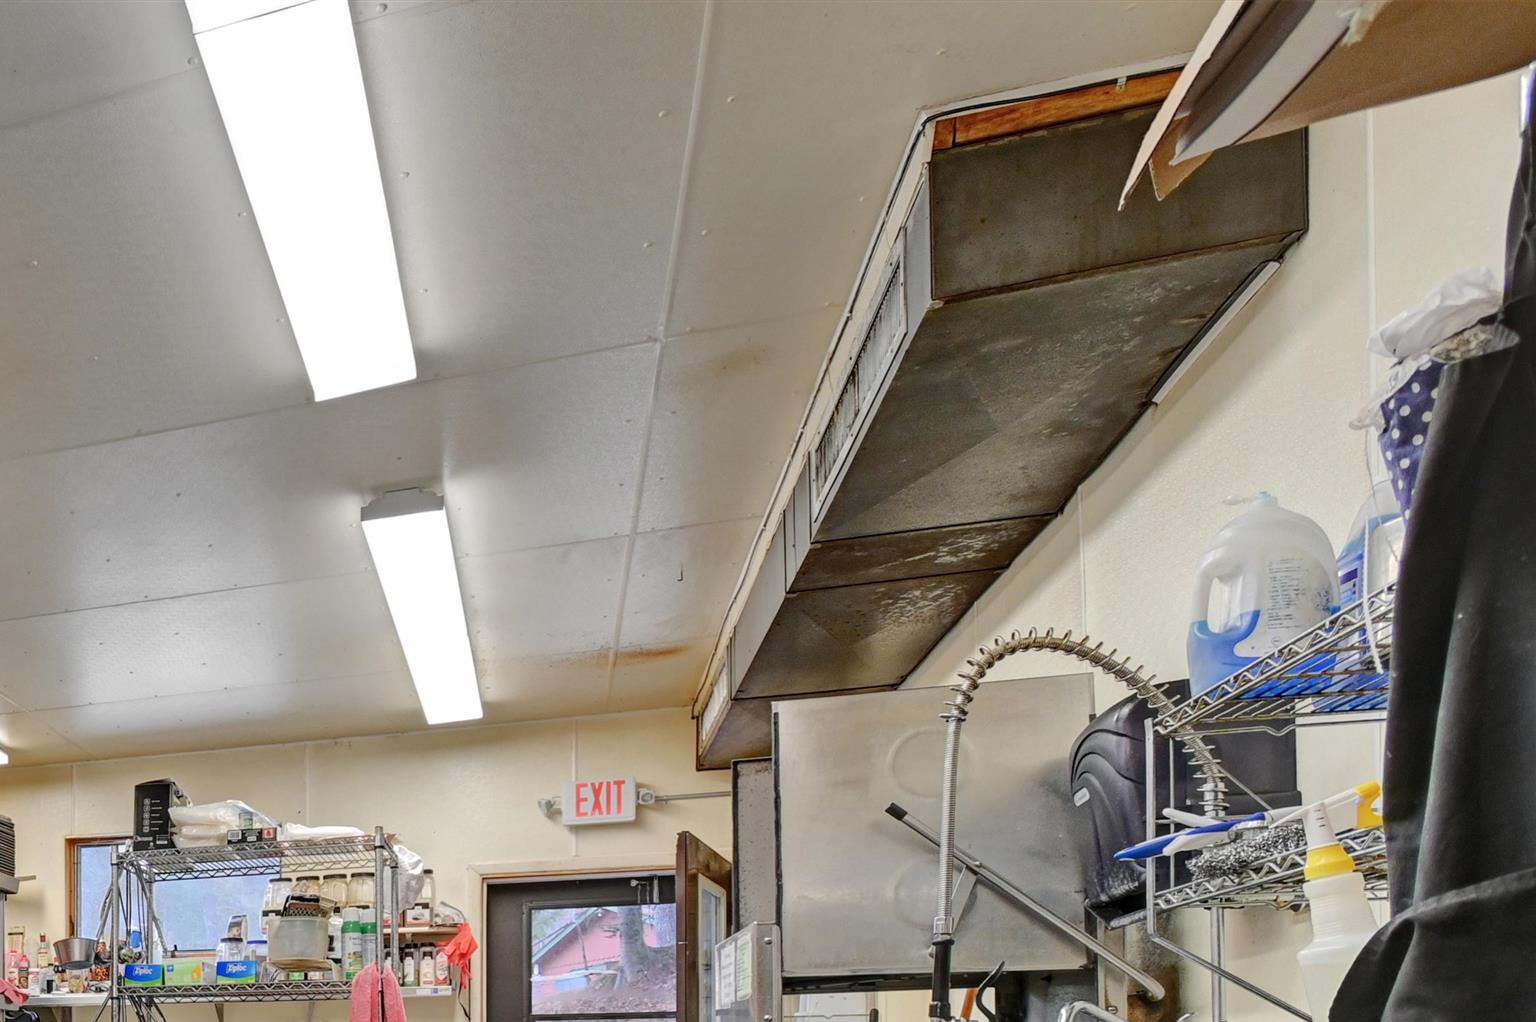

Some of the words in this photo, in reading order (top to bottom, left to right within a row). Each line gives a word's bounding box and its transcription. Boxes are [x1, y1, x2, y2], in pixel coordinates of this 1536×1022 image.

[575, 779, 626, 818] EXIT
[134, 966, 153, 976] Ziploc
[227, 963, 247, 974] Ziploc
